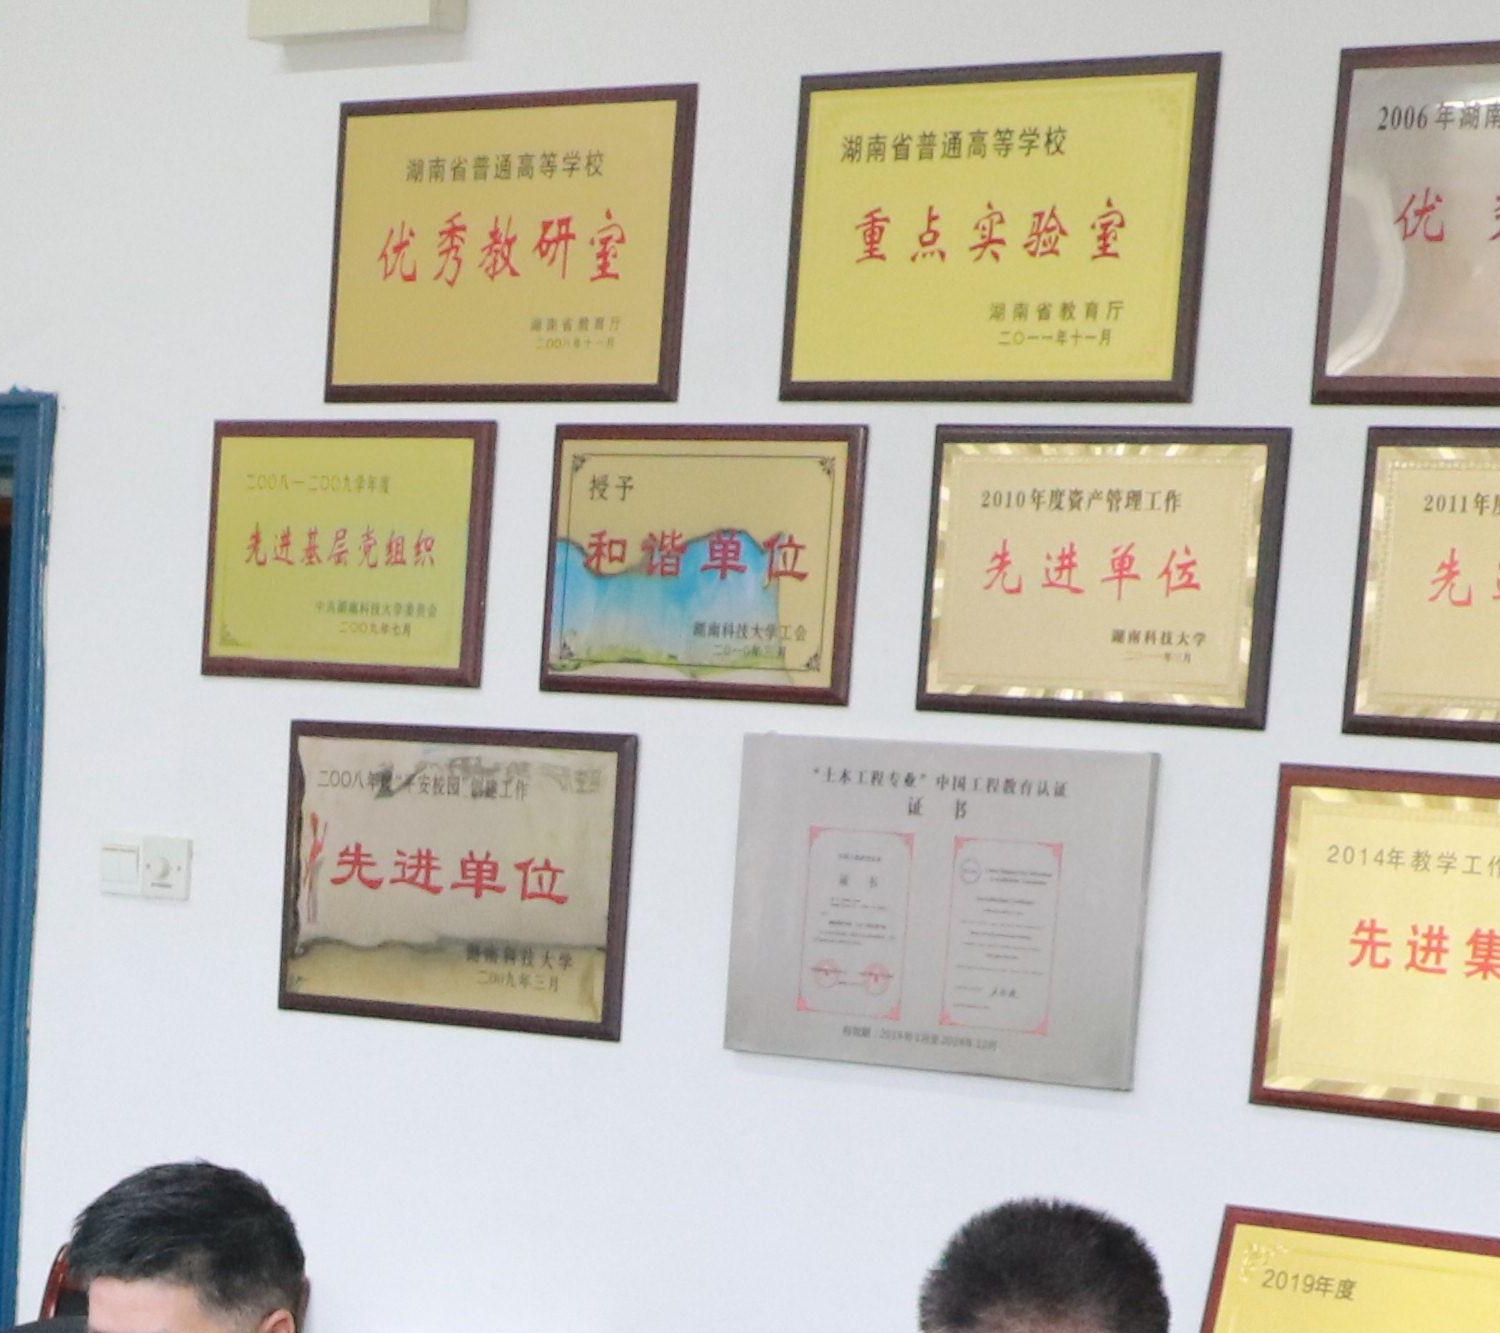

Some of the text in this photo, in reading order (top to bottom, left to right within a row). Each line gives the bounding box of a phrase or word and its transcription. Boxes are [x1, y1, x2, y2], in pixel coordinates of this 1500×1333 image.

[840, 126, 1069, 163] 湖南省普通高等学校
[406, 151, 605, 183] 湖南省普通高等学校
[378, 209, 626, 287] 优秀教研室
[855, 198, 1127, 264] 重点实验室
[989, 300, 1124, 322] 湖南省教育厅
[589, 474, 634, 501] 授予
[981, 489, 1183, 514] 2010年度资产管理工作
[246, 522, 435, 568] 先进基层党组织
[584, 529, 808, 590] 和谐单位
[983, 539, 1202, 600] 先进单位
[1111, 629, 1207, 647] 湖南科技大学
[907, 797, 968, 820] 证书
[331, 842, 569, 905] 先进单位
[1262, 1268, 1357, 1300] 2019年度
